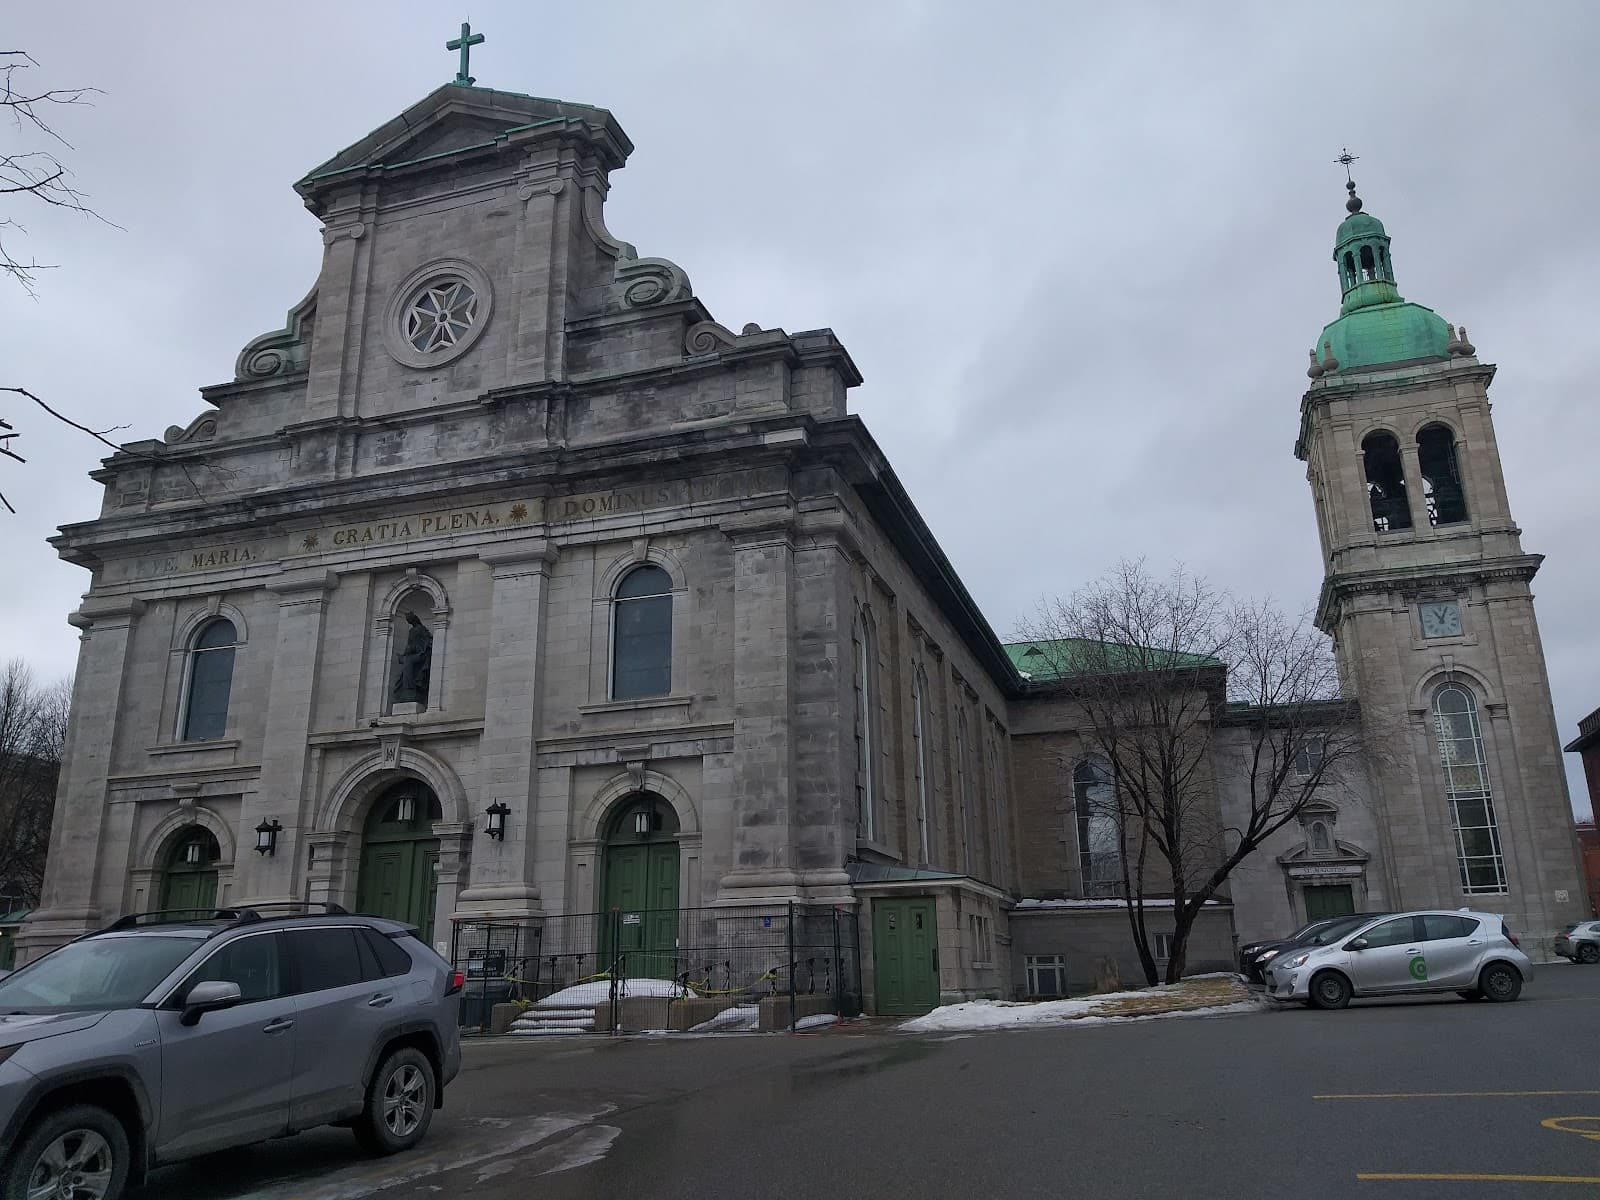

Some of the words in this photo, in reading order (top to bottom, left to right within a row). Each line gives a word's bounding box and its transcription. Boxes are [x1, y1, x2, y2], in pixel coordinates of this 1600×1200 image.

[191, 547, 256, 568] MARIA,
[334, 521, 412, 545] GRATIA
[421, 509, 500, 533] PLENA,
[564, 488, 670, 516] DOMINUS
